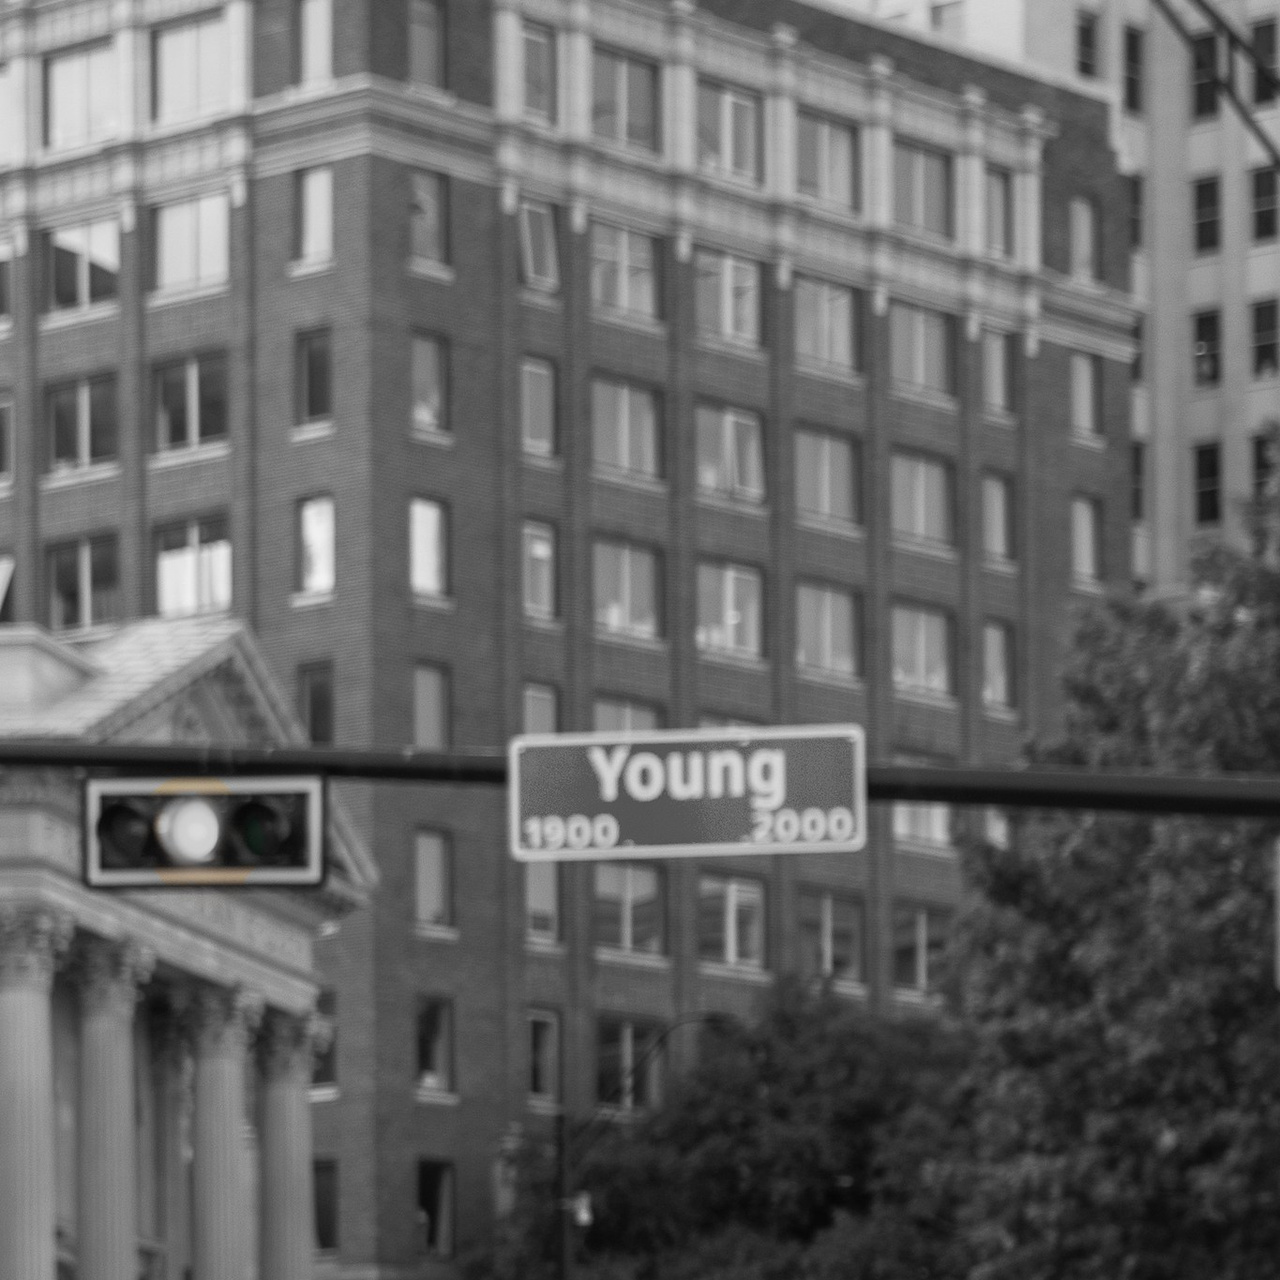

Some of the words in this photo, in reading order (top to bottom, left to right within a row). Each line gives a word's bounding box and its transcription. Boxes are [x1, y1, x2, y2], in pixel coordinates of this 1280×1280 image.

[588, 745, 786, 811] Young
[524, 813, 620, 850] 1900
[752, 806, 853, 843] 2000
